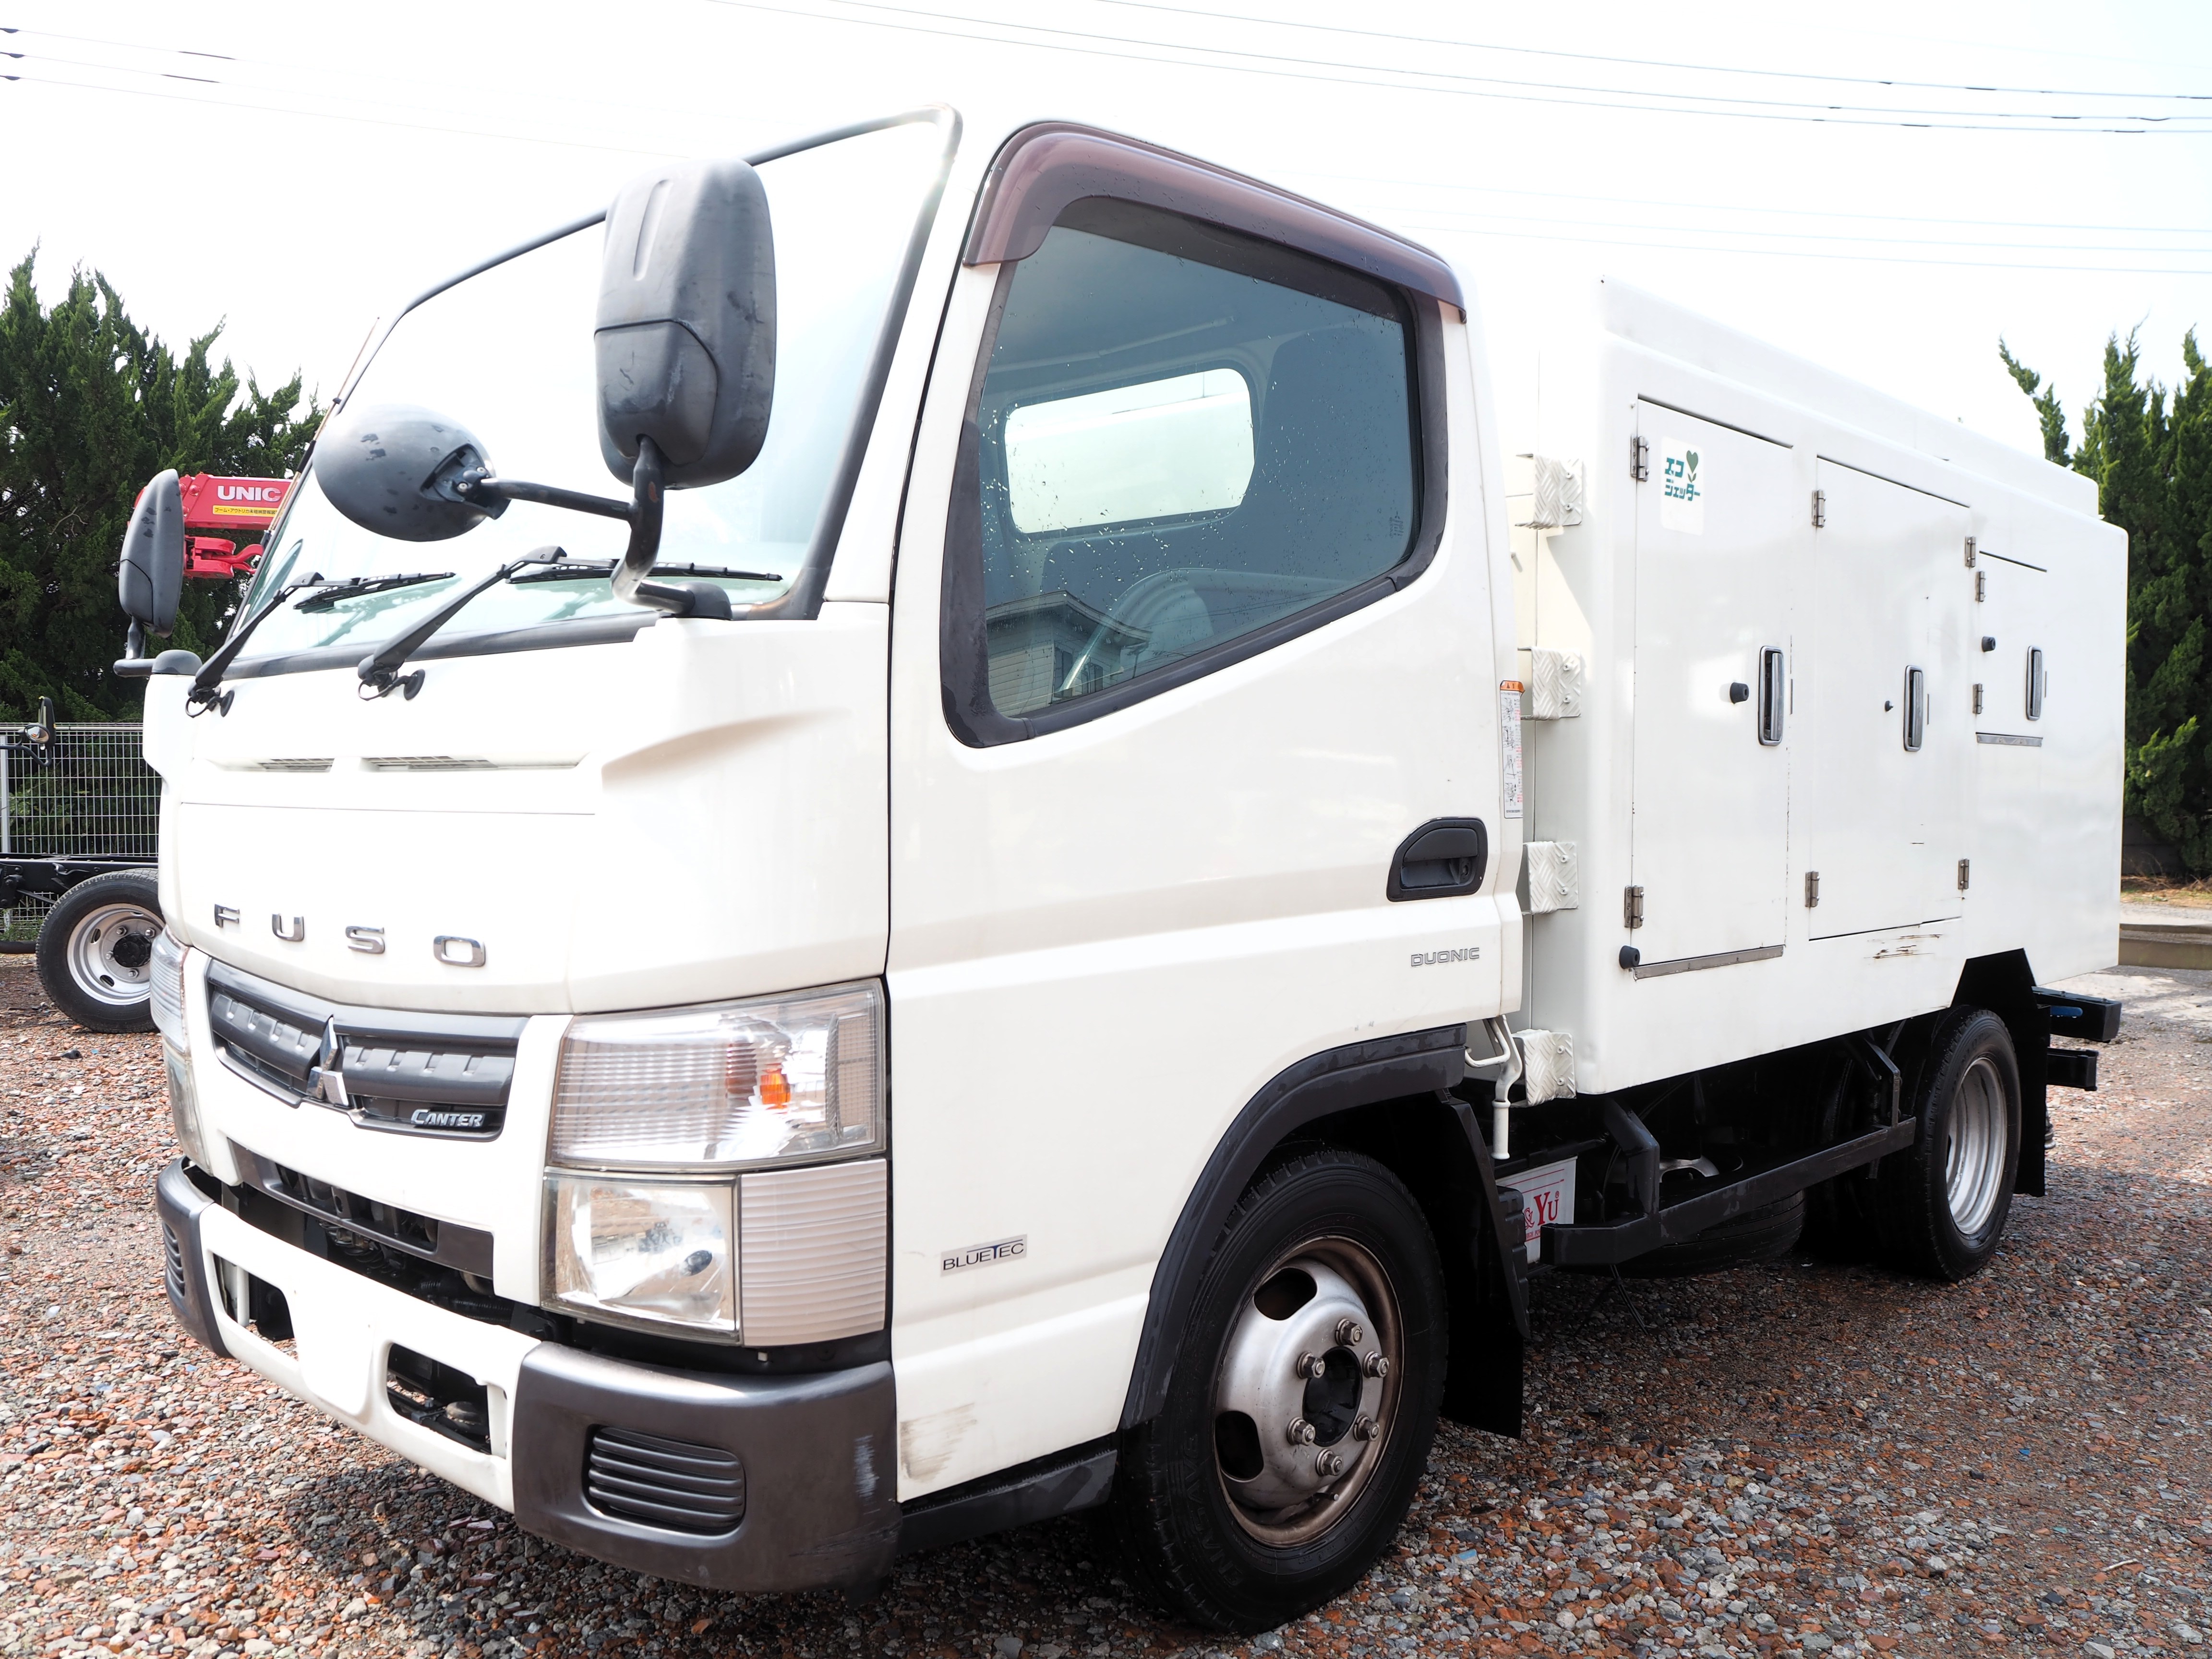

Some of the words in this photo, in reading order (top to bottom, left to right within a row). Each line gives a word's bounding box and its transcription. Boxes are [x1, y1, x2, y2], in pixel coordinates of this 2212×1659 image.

[1664, 457, 1685, 478] エコ
[217, 485, 282, 502] UNIC
[1664, 478, 1700, 501] ジェッター
[214, 903, 486, 967] FUSO
[1411, 947, 1479, 967] DUONIC
[410, 1108, 483, 1128] CANTER
[943, 1239, 1024, 1271] BLUETEC
